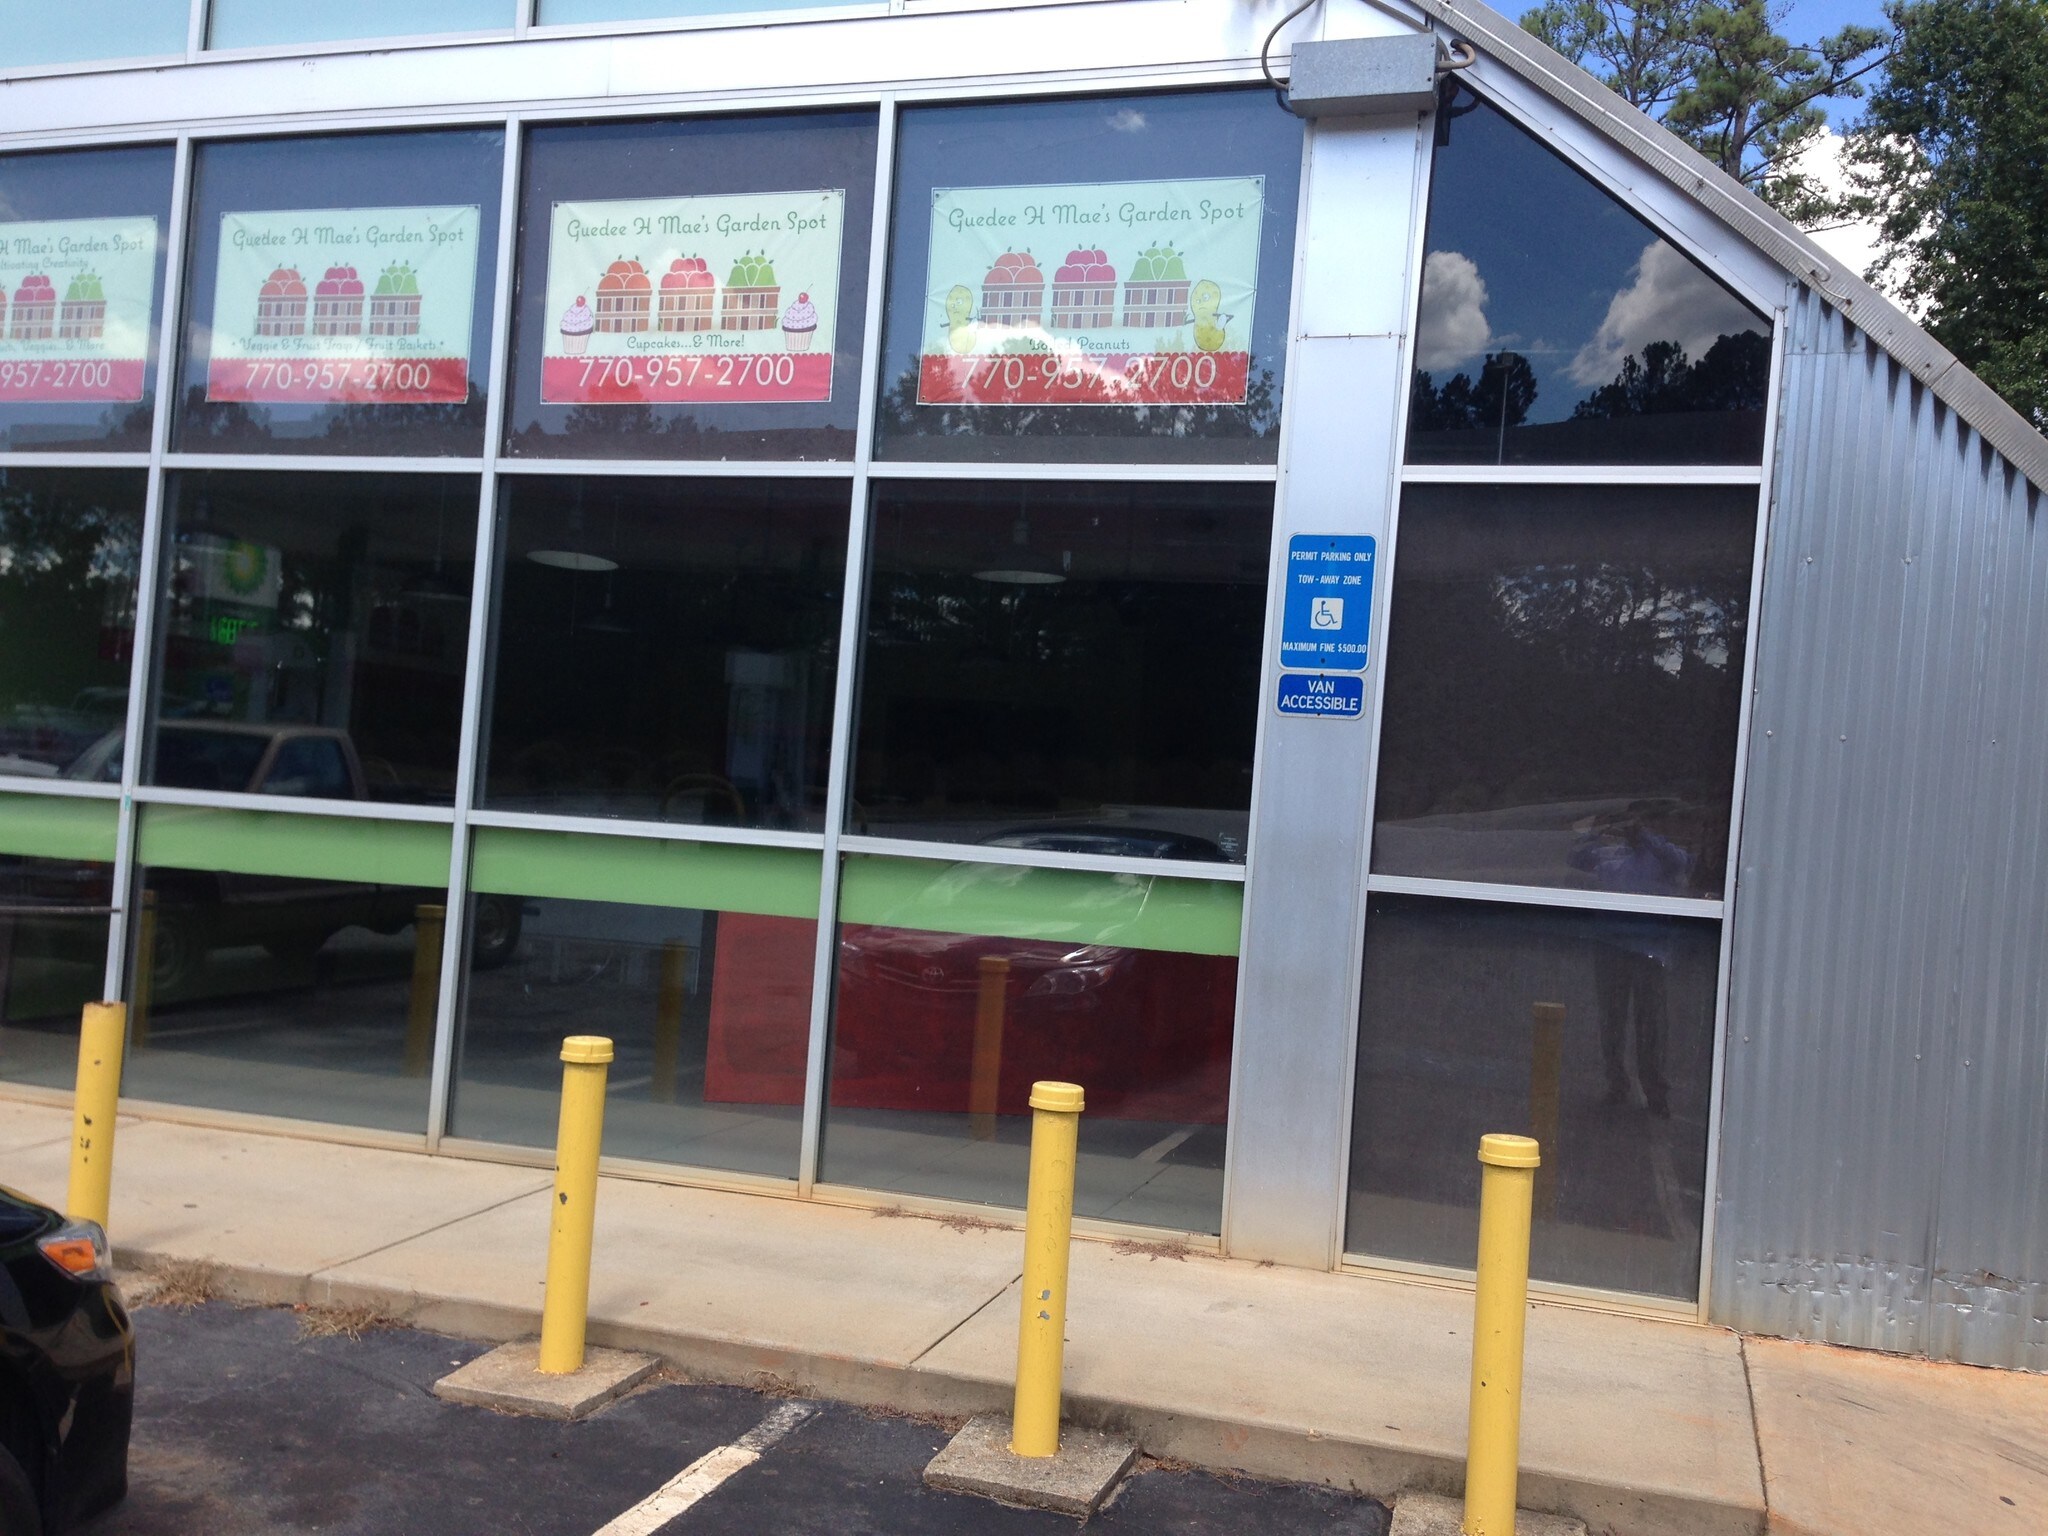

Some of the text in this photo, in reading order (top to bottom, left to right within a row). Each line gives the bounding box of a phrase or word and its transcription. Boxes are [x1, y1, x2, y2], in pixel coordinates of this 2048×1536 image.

[949, 207, 1017, 232] Guedee
[1051, 203, 1111, 225] Mae's
[1118, 201, 1192, 231] Garden
[1199, 199, 1245, 225] Spot
[566, 219, 627, 242] Guedee
[657, 214, 709, 235] Mae's
[715, 212, 781, 238] Garden
[787, 210, 827, 235] Spot
[232, 228, 287, 249] Guedee
[314, 225, 360, 245] Mae's
[365, 224, 424, 248] Garden
[428, 223, 464, 244] Spot
[14, 237, 54, 255] Mae's
[58, 235, 109, 257] Garden
[113, 233, 144, 254] Spot
[240, 338, 278, 352] Veggie
[281, 337, 289, 350] &
[365, 336, 392, 351] Fruit
[706, 333, 745, 348] More!
[1077, 336, 1131, 351] Peanuts
[245, 362, 431, 390] 770-957-2700
[578, 355, 795, 387] 770-957-2700
[961, 355, 1216, 390] 770-957-2700
[1291, 551, 1372, 562] PERMIT PARKING ONLY
[1343, 575, 1362, 585] ZONE
[1282, 641, 1367, 654] MAXIMUM FINE $500.00
[1307, 680, 1335, 694] VAN
[1280, 694, 1359, 711] ACCESSIBLE
